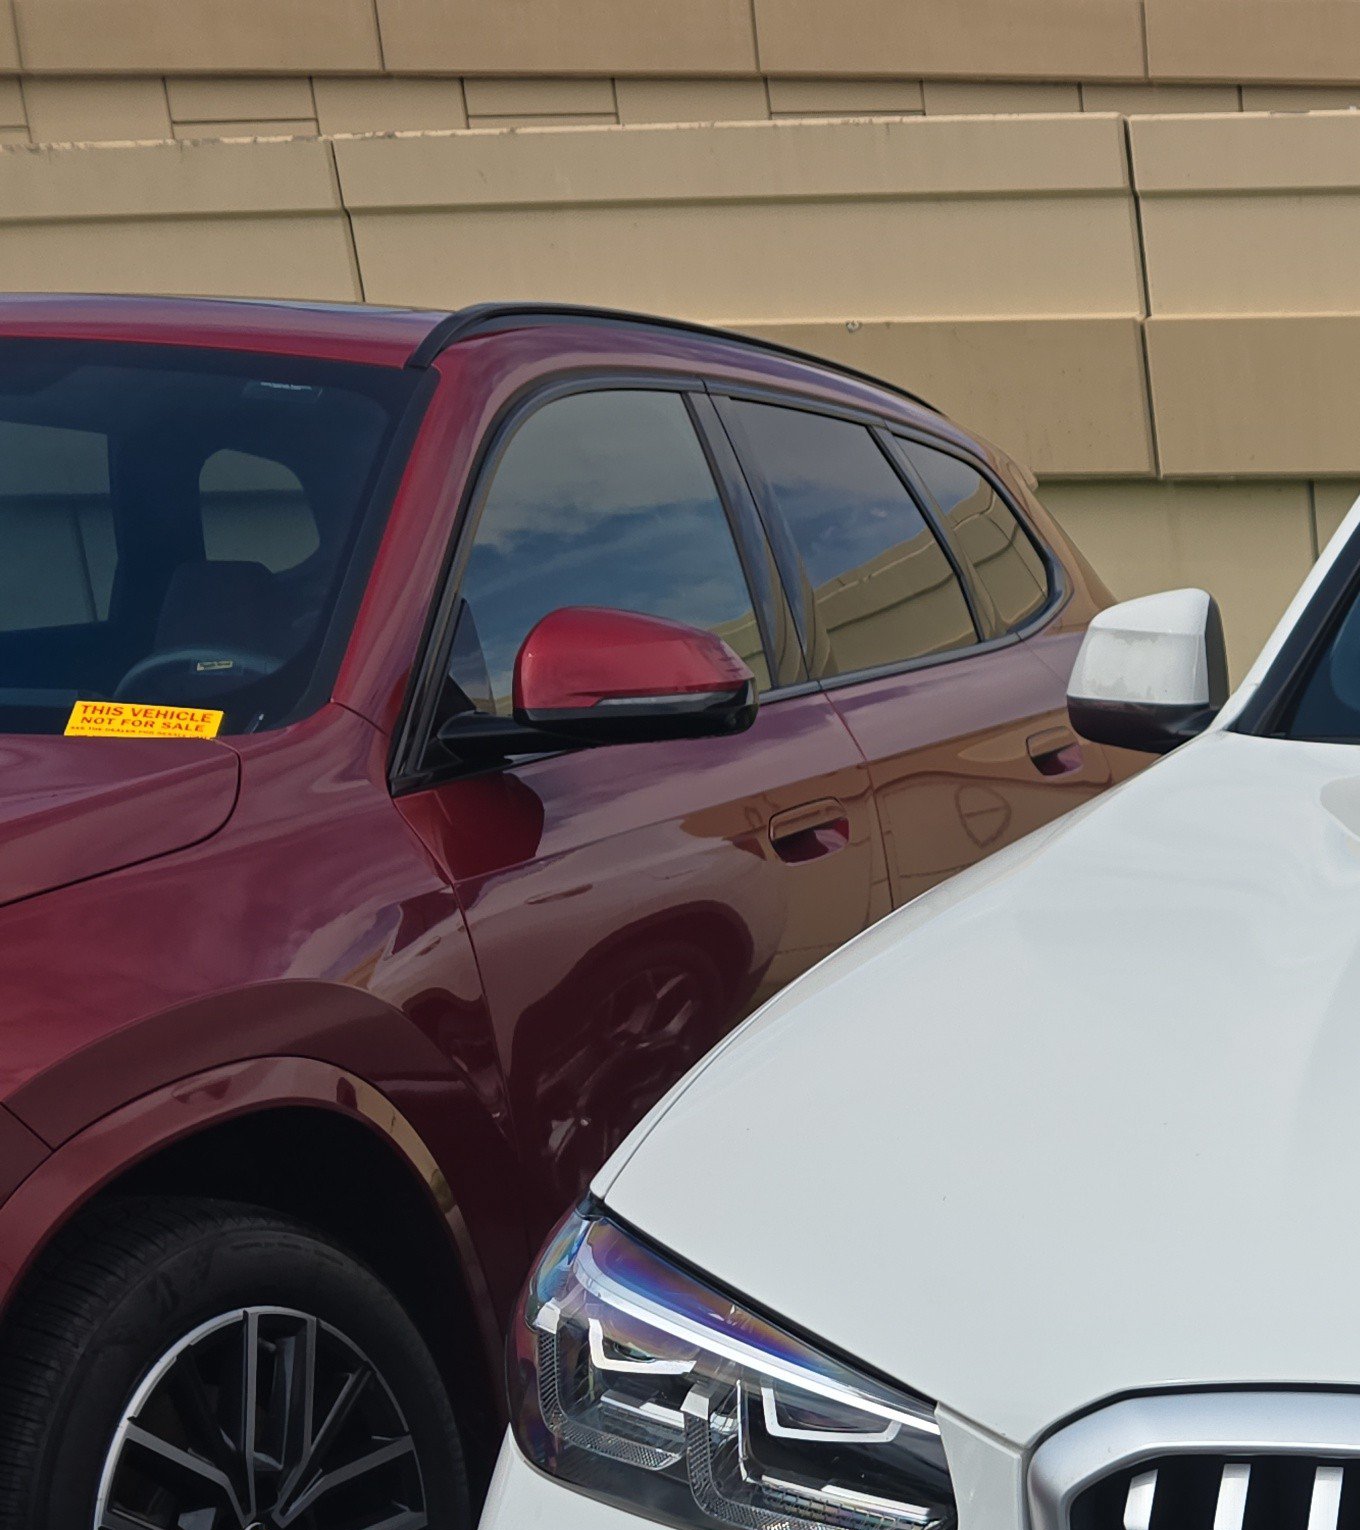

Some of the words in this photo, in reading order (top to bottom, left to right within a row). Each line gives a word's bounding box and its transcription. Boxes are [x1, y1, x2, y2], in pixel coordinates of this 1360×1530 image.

[81, 705, 124, 716] THIS
[131, 707, 214, 723] VEHICLE
[81, 716, 116, 725] NOT
[121, 718, 155, 729] FOR
[161, 721, 205, 733] SALE
